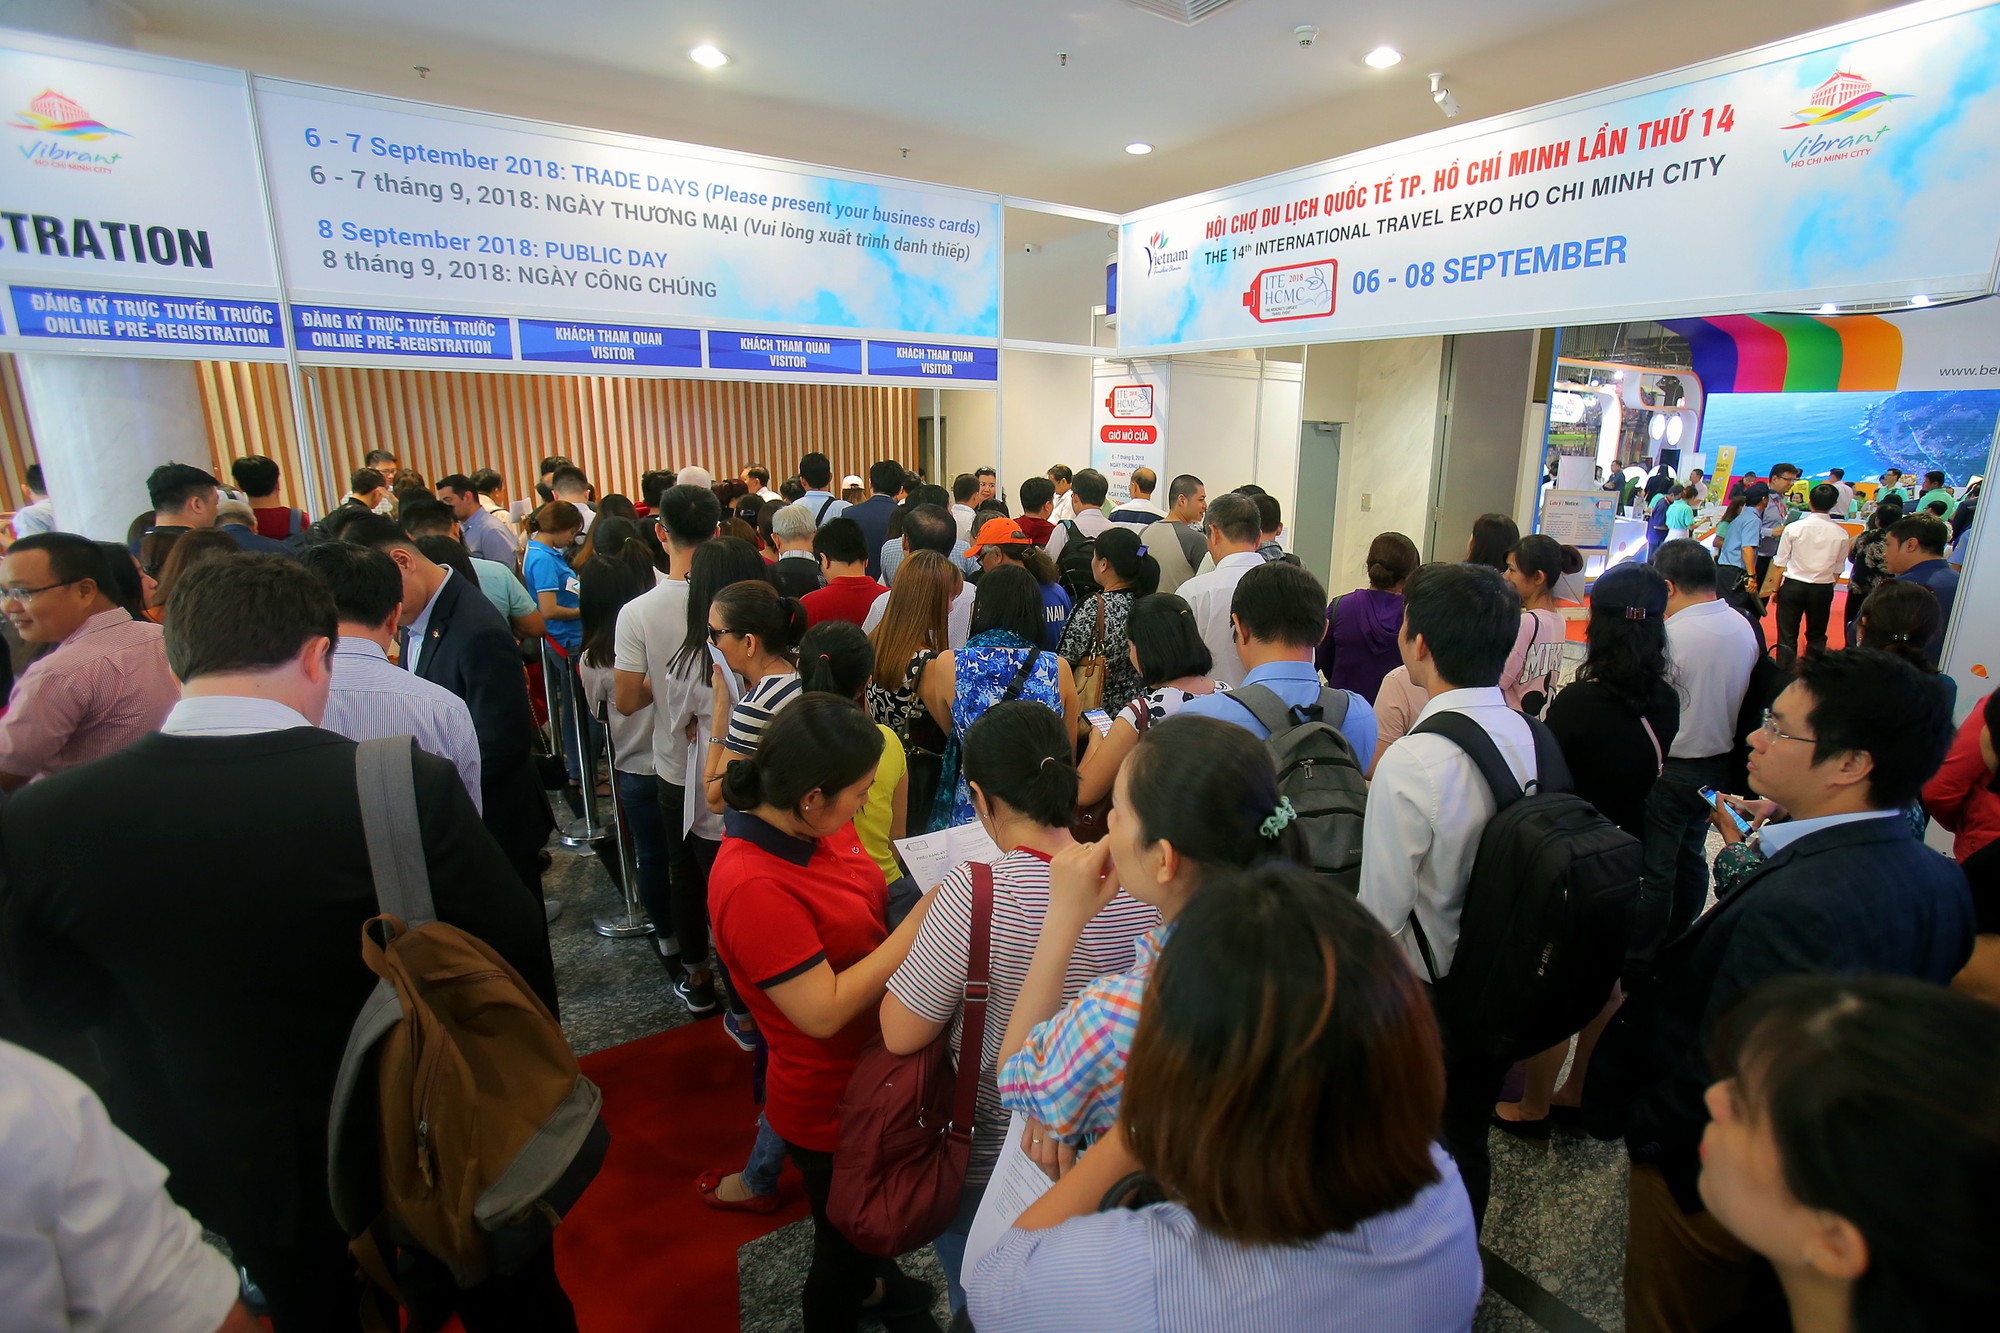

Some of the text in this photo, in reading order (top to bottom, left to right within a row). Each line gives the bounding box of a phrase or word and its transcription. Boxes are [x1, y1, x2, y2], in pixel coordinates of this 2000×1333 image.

[19, 140, 123, 165] Vibrant
[1782, 125, 1891, 164] Vibrant
[34, 159, 113, 174] HO CHI MINH CITY
[1790, 148, 1872, 169] HO CHI MINH CITY
[304, 127, 320, 147] 6
[346, 133, 361, 153] 7
[370, 137, 498, 171] September
[505, 156, 566, 180] 2018:
[572, 164, 641, 190] TRADE
[646, 175, 700, 198] DAYS
[705, 182, 767, 207] (Please
[771, 195, 832, 216] present
[835, 204, 869, 220] your
[873, 205, 935, 229] business
[939, 217, 982, 237] cards)
[1205, 104, 1735, 242] HỘI CHỢ DU LỊCH QUỐC TẾ TP. HỒ CHÍ MINH LẦN THỨ 14
[310, 165, 326, 184] 6
[350, 170, 366, 189] 7
[374, 173, 444, 203] tháng
[450, 182, 471, 205] 9,
[477, 185, 539, 209] 2018:
[546, 192, 604, 217] NGÀY
[611, 201, 697, 228] THƯƠNG
[703, 213, 738, 235] MẠI
[744, 217, 777, 237] (Vui
[781, 221, 815, 245] lòng
[818, 226, 852, 246] xuất
[856, 232, 890, 250] trình
[894, 236, 928, 255] danh
[932, 241, 971, 263] thiếp)
[1204, 154, 1728, 265] THE 14th INTERNATIONAL TRAVEL EXPO HO CHI MINH CITY
[0, 211, 213, 268] TRATION
[318, 219, 668, 270] 8 September 2018: PUBLIC DAY
[322, 249, 717, 298] 8 tháng 9, 2018: NGÀY CÔNG CHÚNG
[1144, 247, 1188, 277] Vietnam
[1352, 269, 1380, 295] 06
[1405, 262, 1435, 289] 08
[1442, 234, 1628, 284] SEPTEMBER
[1265, 273, 1304, 290] ITE 2018
[1265, 287, 1305, 305] HCMC
[32, 292, 274, 325] ĐĂNG KÝ TRỰC TUYẾN TRƯỚC
[45, 317, 271, 344] ONLINE PRE-REGISTRATION
[302, 311, 496, 337] ĐĂNG KÝ TRỰC TUYẾN TRƯỚC
[555, 325, 663, 346] KHÁCH THAM QUAN
[312, 331, 492, 355] ONLINE PRE-REGISTRATION
[590, 345, 636, 361] VISITOR
[740, 336, 831, 356] KHÁCH THAM QUAN
[896, 345, 974, 363] KHÁCH THAM QUAN
[769, 354, 807, 369] VISITOR
[921, 361, 953, 375] VISITOR
[1117, 390, 1128, 399] ITE
[1117, 399, 1138, 409] HCMC
[1108, 428, 1149, 441] GIỜ MỞ CỬA
[1046, 605, 1065, 623] NAM
